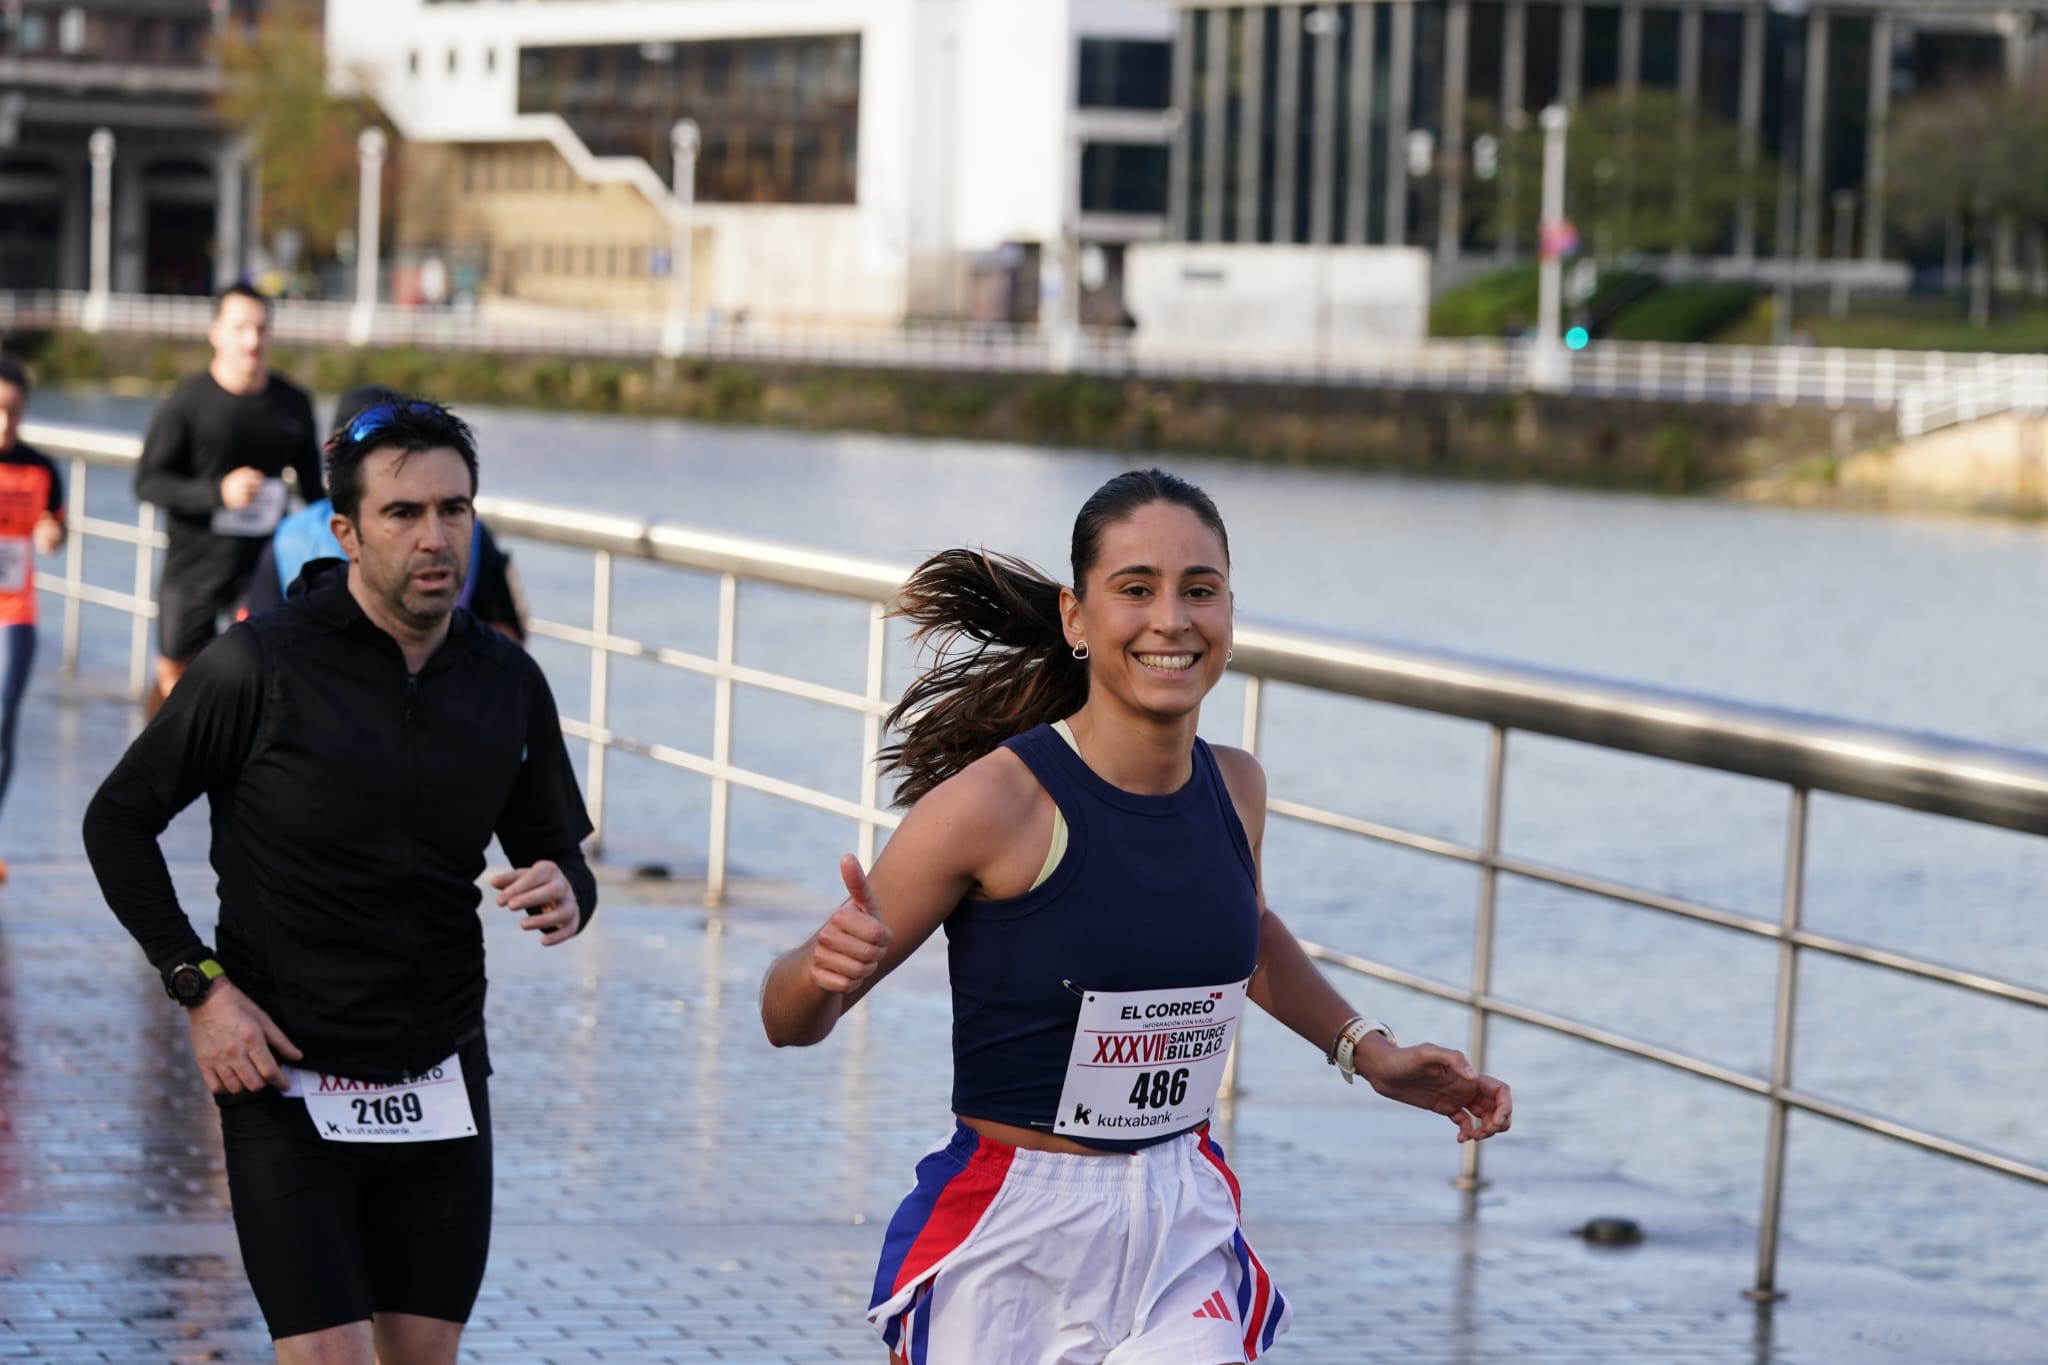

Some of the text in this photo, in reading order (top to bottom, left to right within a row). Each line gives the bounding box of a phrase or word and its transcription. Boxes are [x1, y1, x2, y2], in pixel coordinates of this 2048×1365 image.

[1121, 999, 1216, 1020] EL CORREO
[1194, 1017, 1213, 1025] VALOR
[1092, 1033, 1167, 1063] XXXVII
[1169, 1024, 1227, 1044] SANTURCE
[1166, 1037, 1223, 1060] BILBAO
[1128, 1068, 1190, 1110] 486
[351, 1092, 423, 1125] 2169
[1097, 1111, 1172, 1128] kutxabank
[345, 1126, 411, 1136] kutxabank
